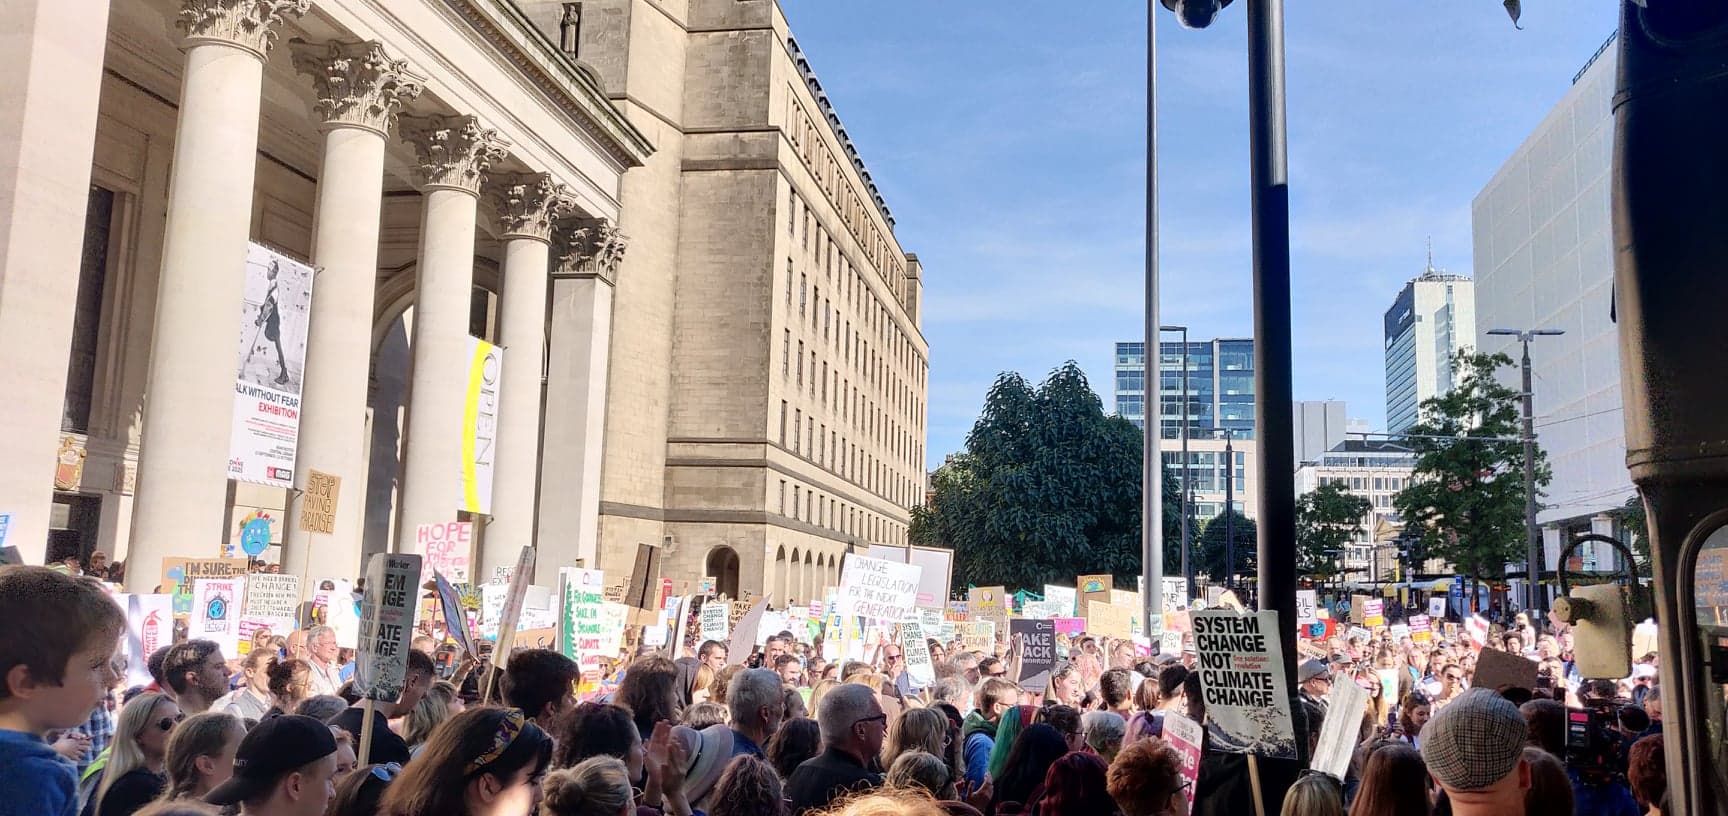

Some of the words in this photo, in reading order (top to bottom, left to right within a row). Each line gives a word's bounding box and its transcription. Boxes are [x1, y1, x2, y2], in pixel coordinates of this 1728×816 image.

[248, 386, 281, 402] WITHOUT
[282, 396, 299, 407] FEAR
[258, 402, 297, 418] EXHIBITION
[476, 353, 497, 465] OPEN
[304, 495, 332, 514] PAVING
[301, 511, 335, 533] PARADISE
[418, 522, 470, 543] HOPE
[426, 541, 456, 555] FOR
[186, 562, 200, 575] I'M
[203, 562, 232, 575] SURE
[854, 557, 888, 574] CHANGE
[207, 583, 233, 591] STRIKE
[861, 572, 919, 594] LEGISLATION
[848, 585, 861, 597] FOR
[864, 588, 874, 600] THE
[876, 592, 897, 603] NEXT
[734, 602, 752, 612] MAKE
[1194, 616, 1260, 634] SYSTEM
[579, 637, 600, 650] CLIMATE
[905, 639, 916, 649] NOT
[1022, 633, 1051, 646] AKE
[1197, 634, 1267, 653] CHANGE
[1023, 646, 1051, 659] ACK
[1200, 652, 1231, 670] NOT
[1203, 669, 1274, 690] CLIMATE
[1206, 687, 1275, 708] CHANGE
